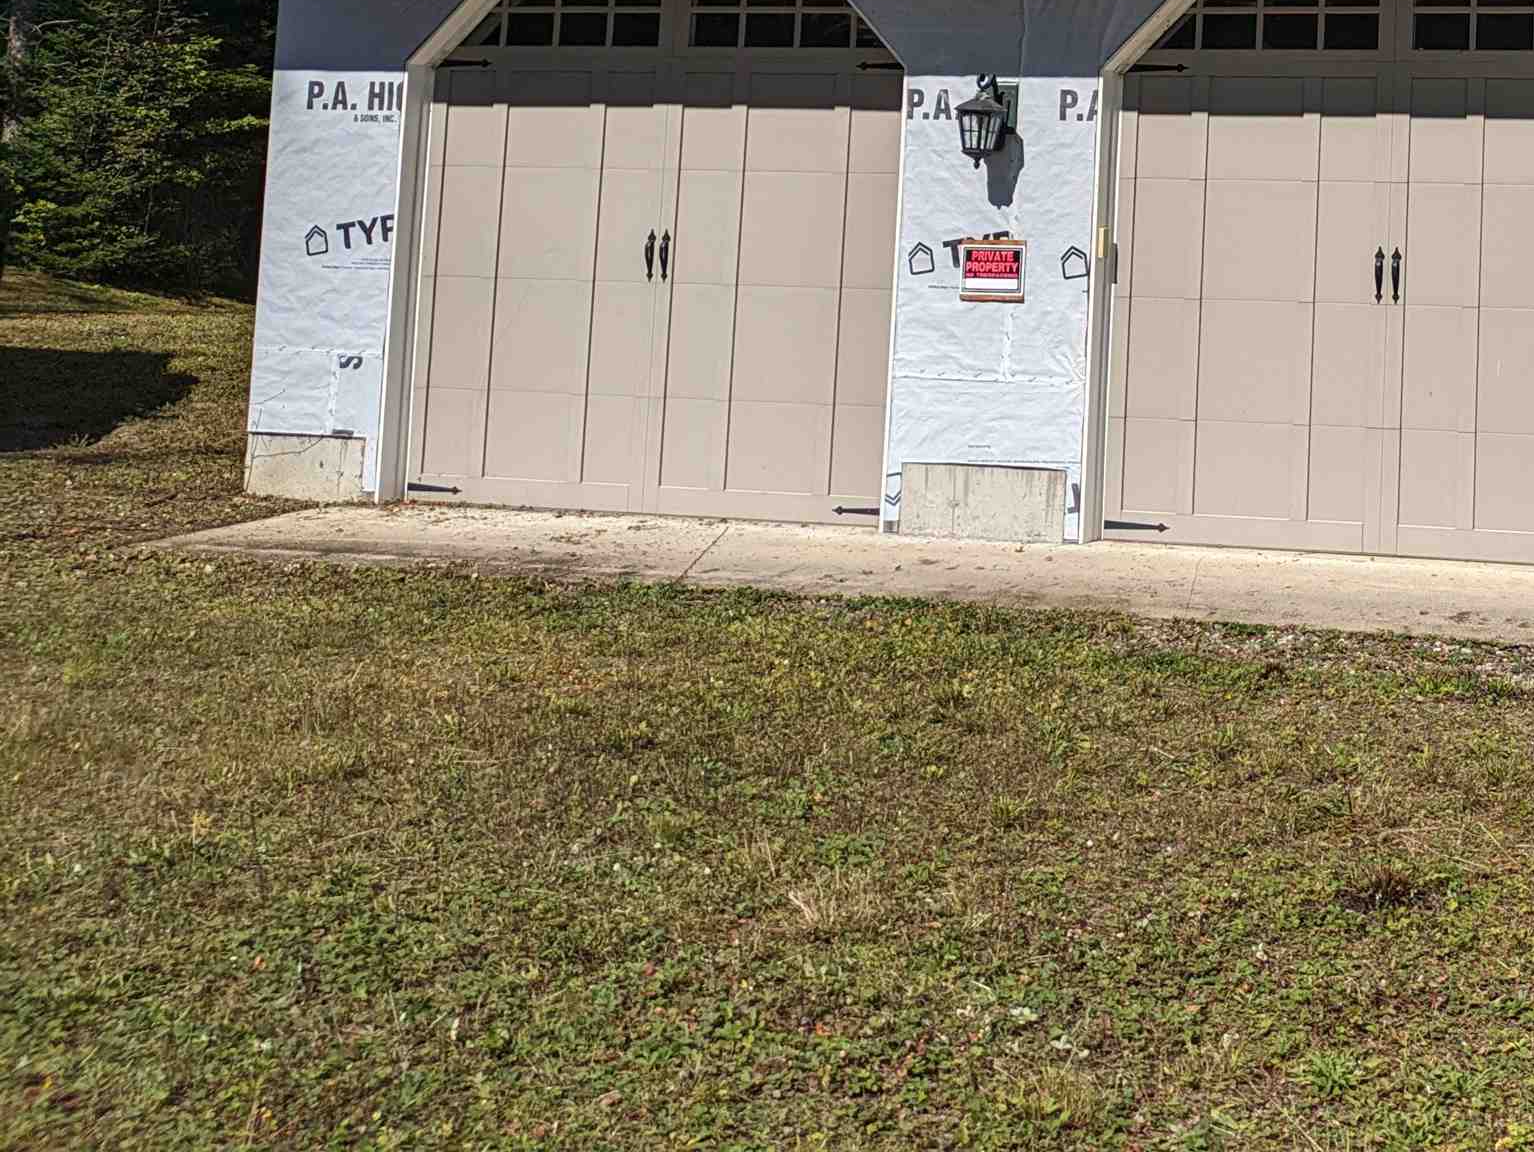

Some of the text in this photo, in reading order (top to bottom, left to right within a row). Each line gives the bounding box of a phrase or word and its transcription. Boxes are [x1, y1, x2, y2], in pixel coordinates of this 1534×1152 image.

[306, 80, 358, 110] P.A.
[971, 250, 1015, 262] PRIVATE
[966, 261, 1018, 273] PROPERTY
